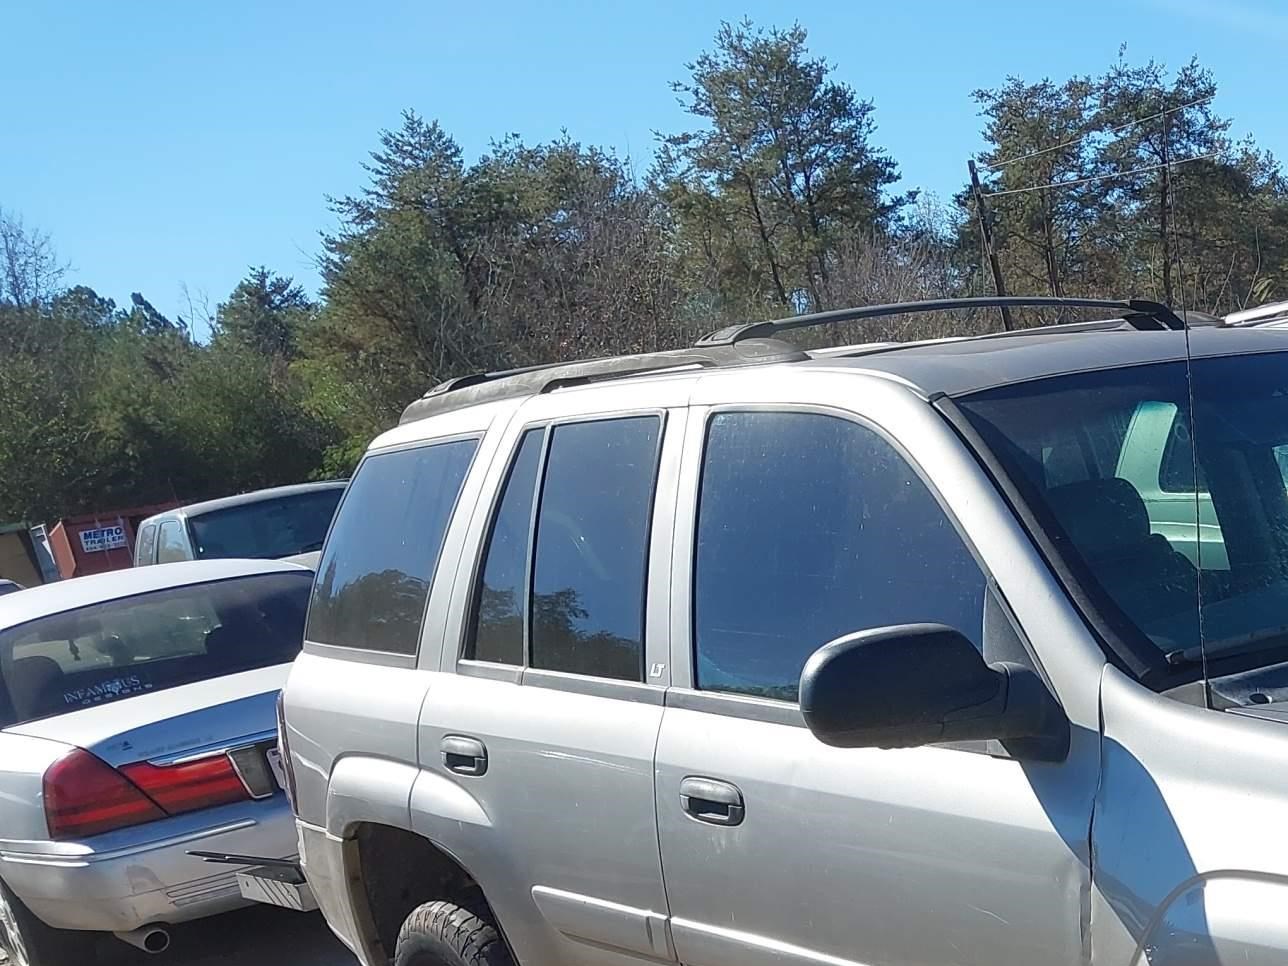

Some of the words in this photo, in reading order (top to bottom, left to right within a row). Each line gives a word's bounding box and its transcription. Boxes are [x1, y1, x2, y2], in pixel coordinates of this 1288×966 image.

[83, 527, 122, 540] METRO
[63, 675, 140, 703] INFAMUS
[82, 683, 153, 705] DESGNS
